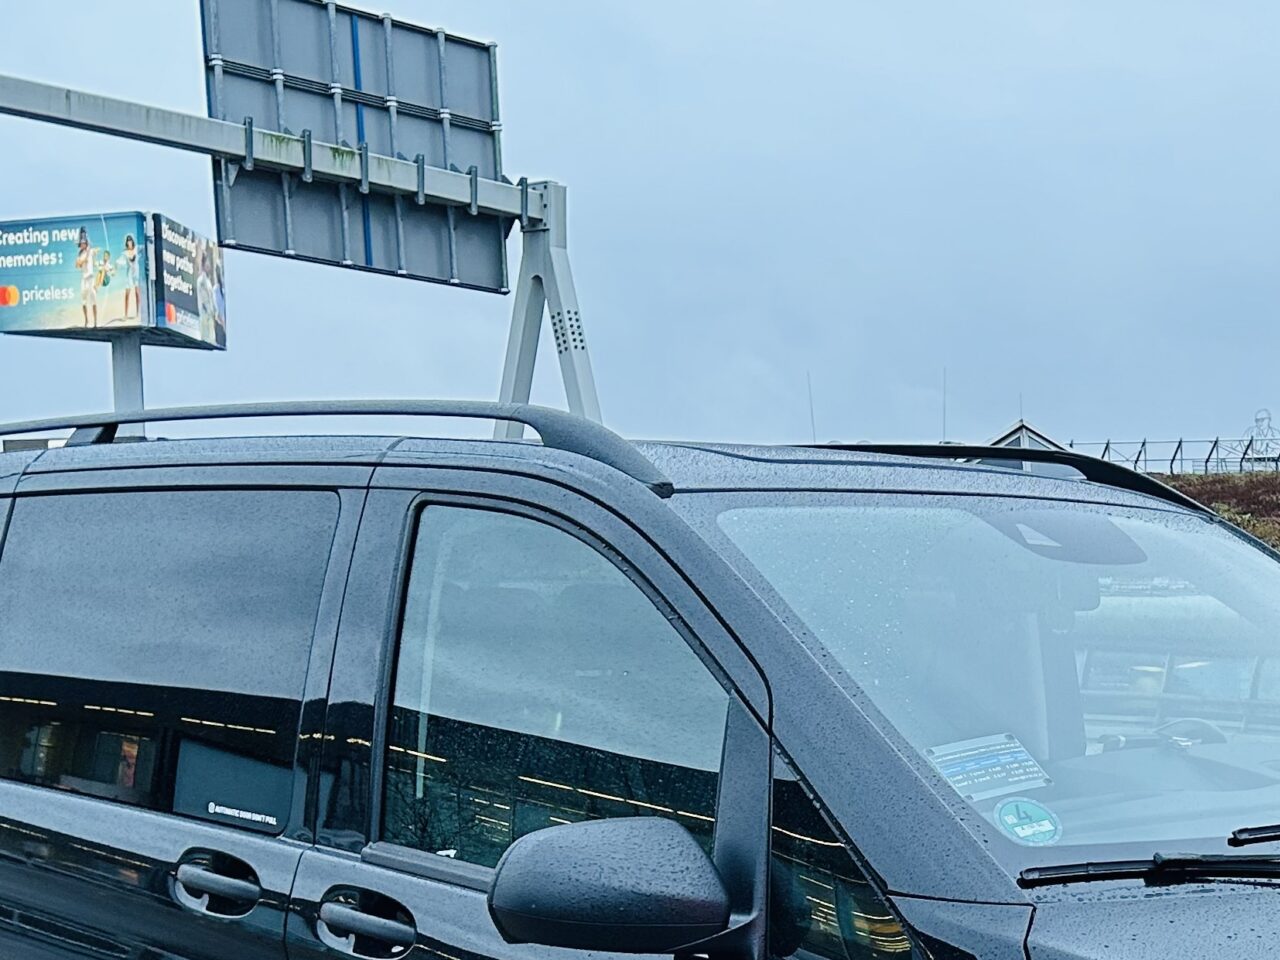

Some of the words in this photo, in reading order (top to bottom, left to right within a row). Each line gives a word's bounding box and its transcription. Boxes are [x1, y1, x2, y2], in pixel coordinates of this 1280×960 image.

[52, 227, 80, 242] new
[162, 223, 196, 258] Discovering
[163, 249, 175, 267] new
[163, 270, 193, 296] together:
[22, 285, 75, 305] priceless
[1015, 804, 1033, 822] 4
